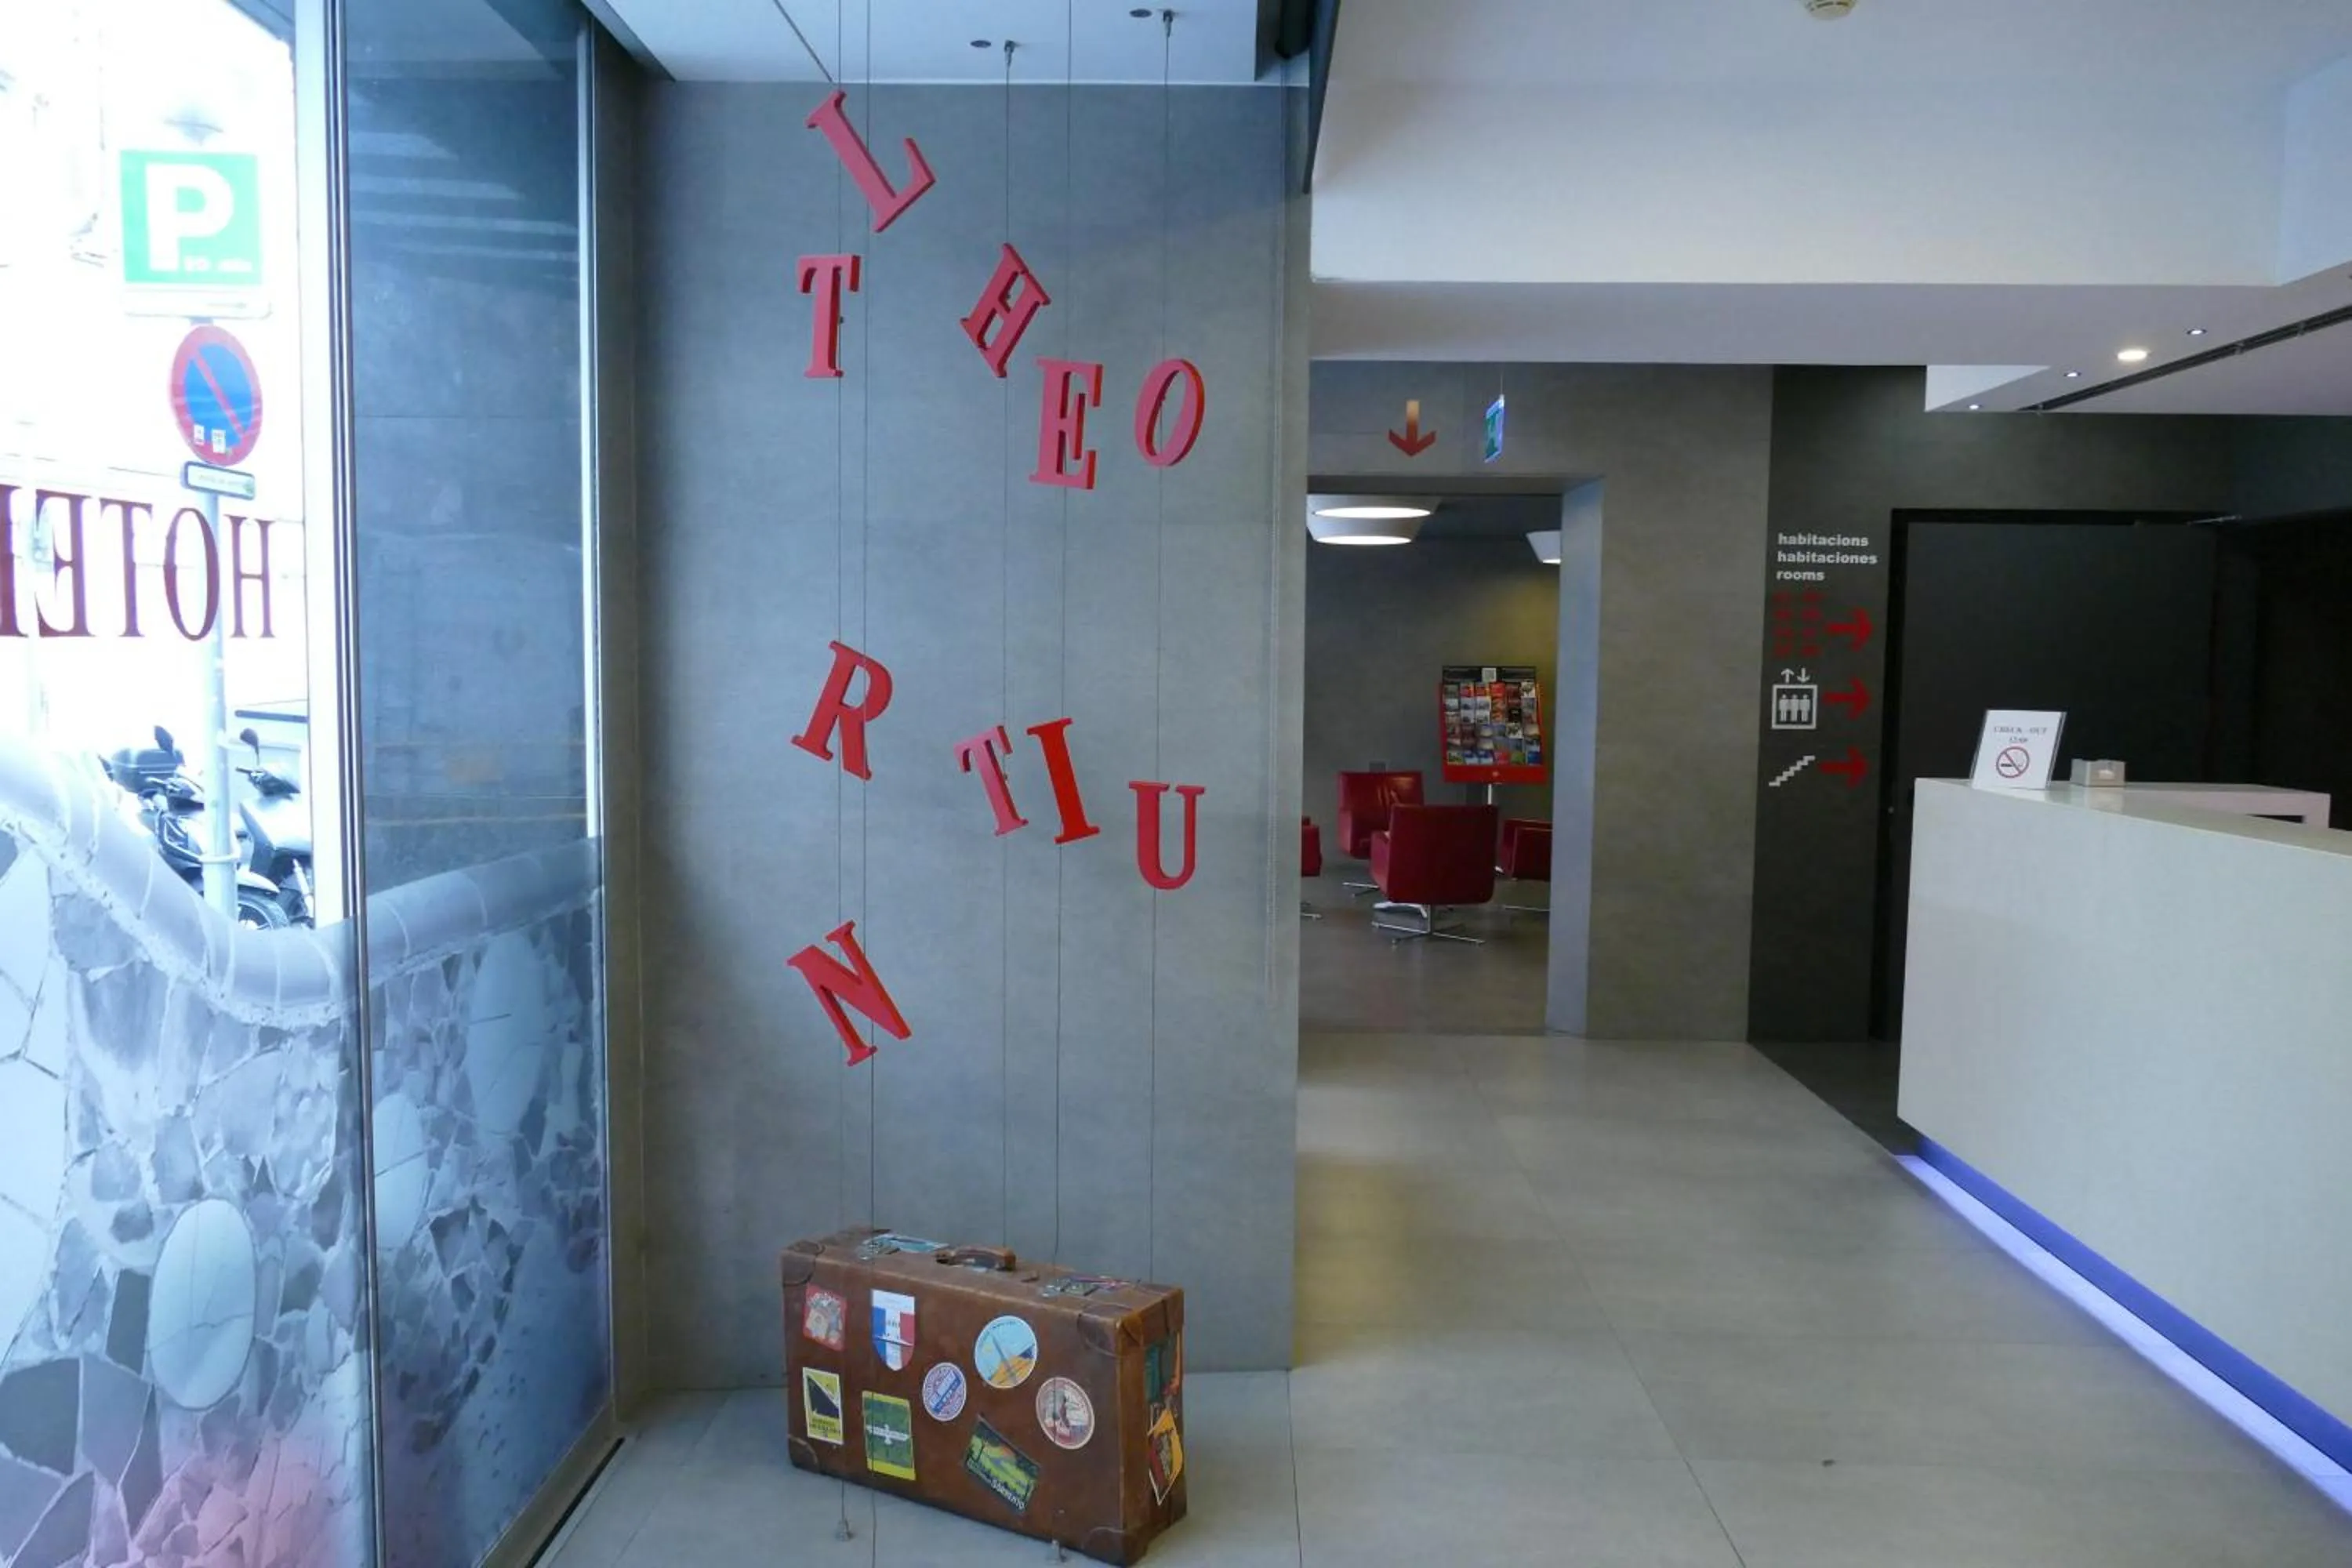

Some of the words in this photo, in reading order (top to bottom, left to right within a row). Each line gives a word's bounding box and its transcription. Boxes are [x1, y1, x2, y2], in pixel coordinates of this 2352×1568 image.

[147, 163, 233, 270] P
[804, 89, 936, 234] L
[797, 253, 861, 378] T
[960, 242, 1051, 378] H
[1029, 356, 1104, 489] E
[1134, 358, 1205, 467] O
[1776, 570, 1825, 581] rooms
[1777, 532, 1869, 546] habitacions
[1777, 550, 1878, 564] habitaciones
[790, 640, 893, 781] R
[953, 724, 1029, 836] T
[1025, 717, 1101, 844] I
[1128, 780, 1206, 890] U
[787, 919, 912, 1067] N
